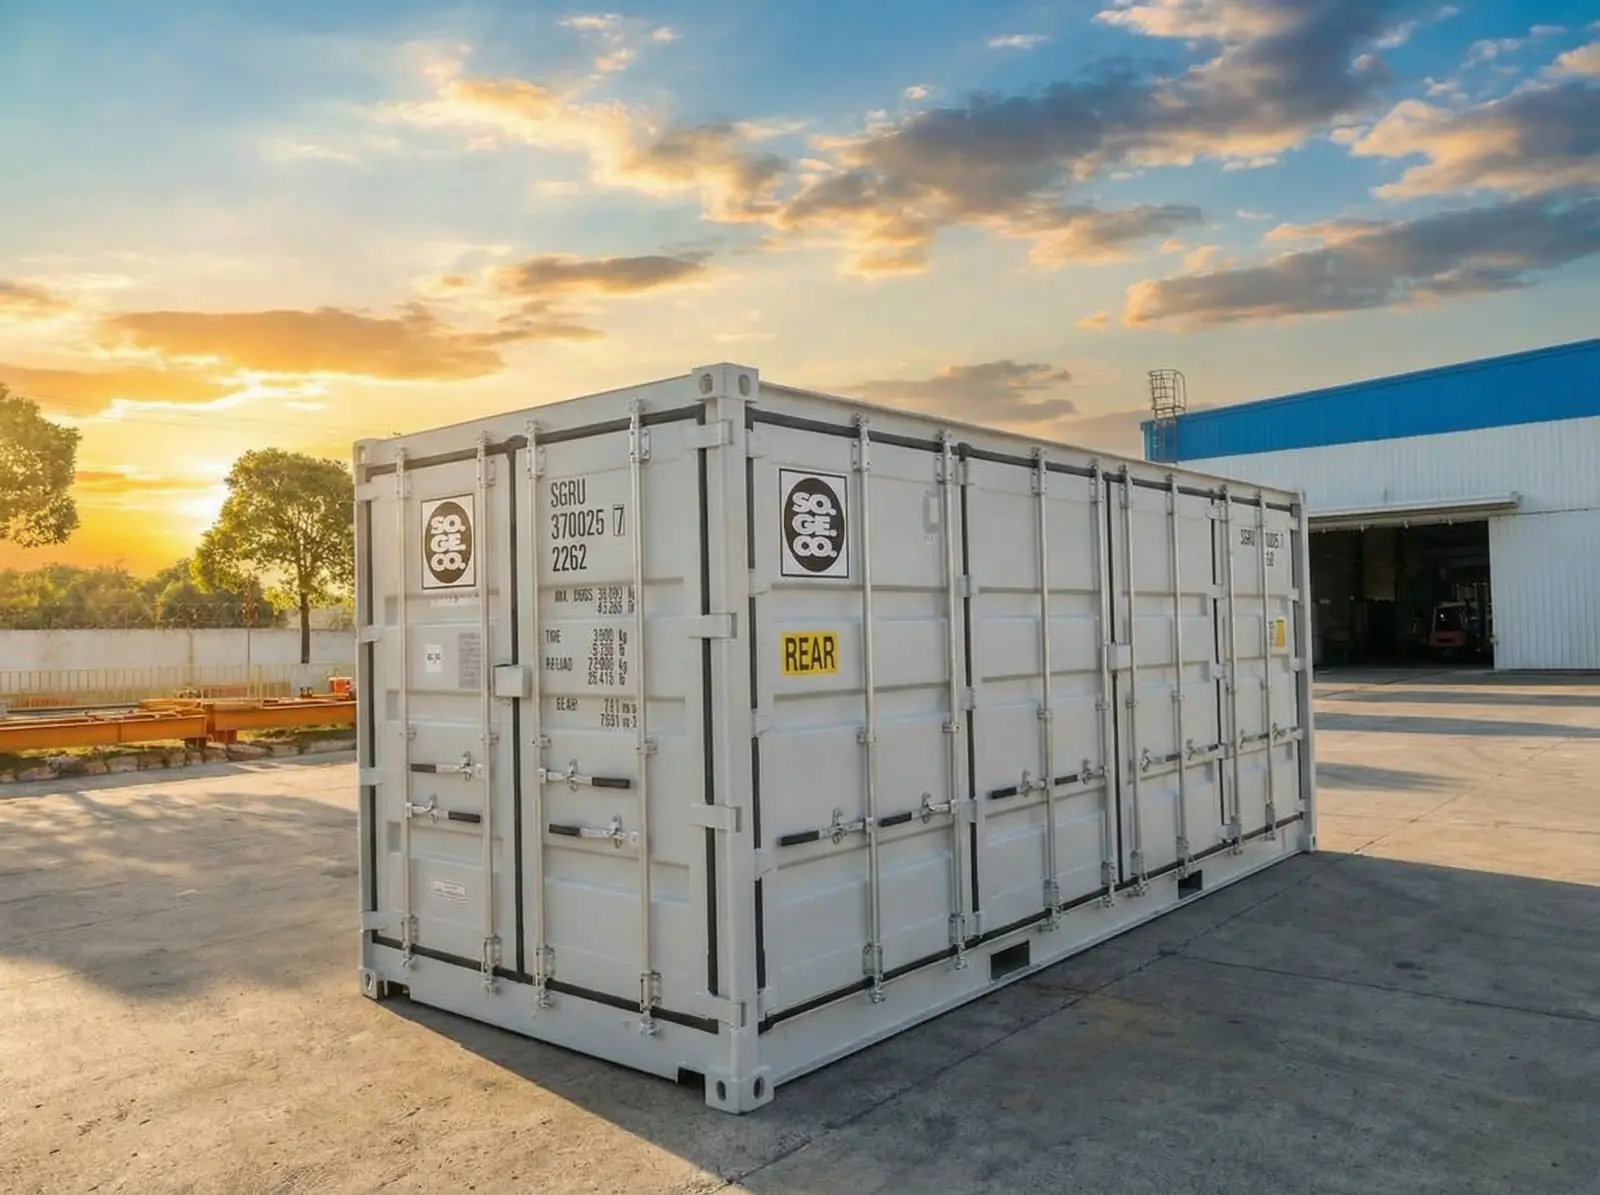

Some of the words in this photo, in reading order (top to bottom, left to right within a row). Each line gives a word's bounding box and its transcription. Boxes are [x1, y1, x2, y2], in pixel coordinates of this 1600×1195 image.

[550, 478, 585, 508] SGRU
[551, 509, 604, 540] 370025
[613, 505, 625, 535] 7
[552, 543, 587, 572] 2262
[784, 635, 836, 672] REAR
